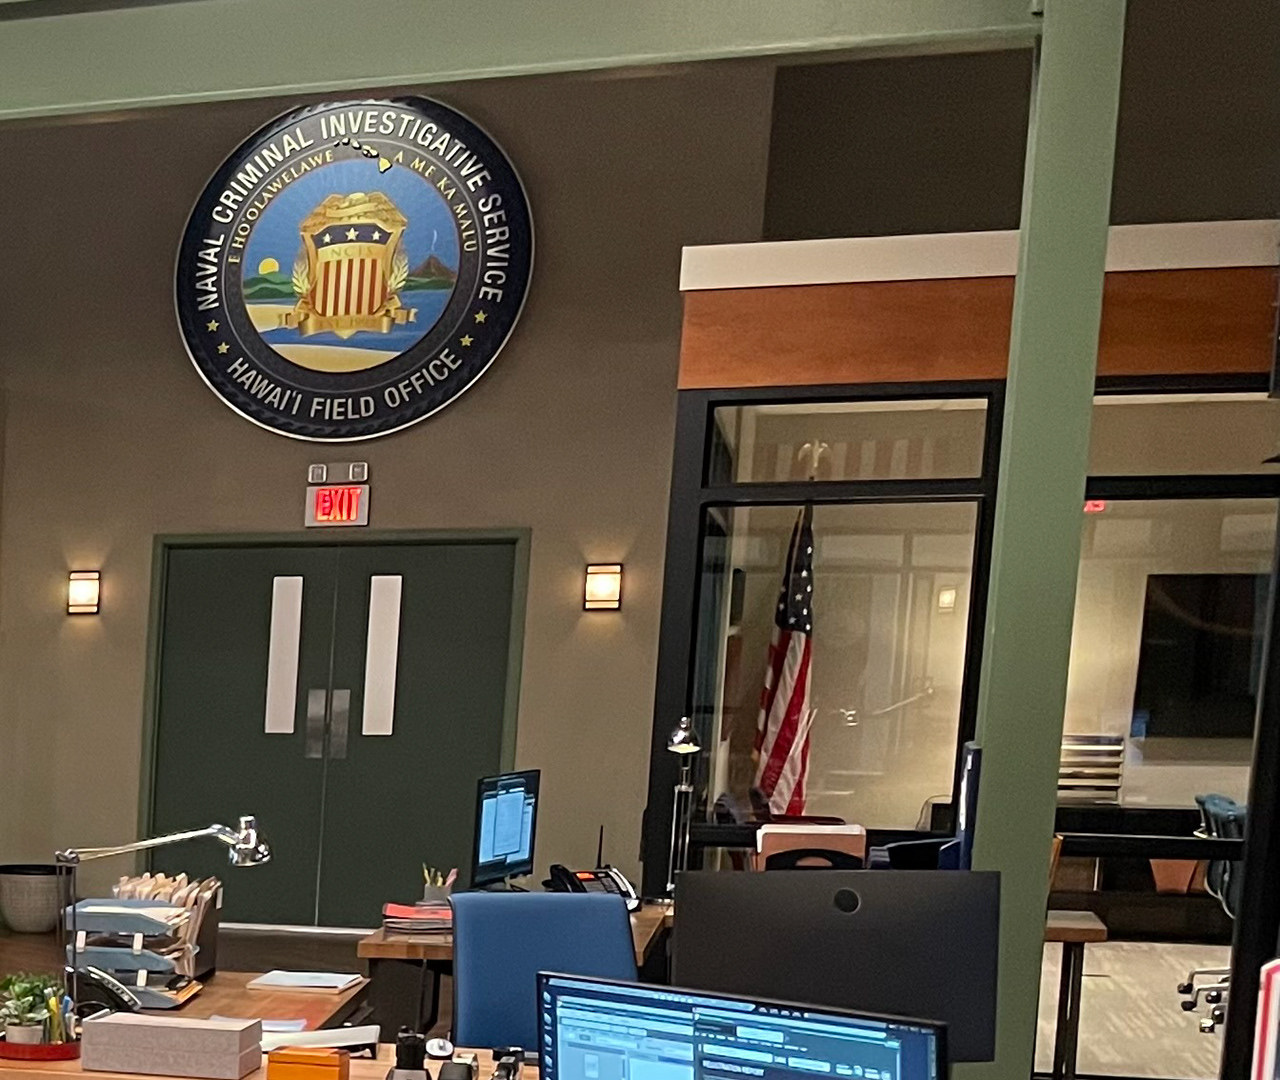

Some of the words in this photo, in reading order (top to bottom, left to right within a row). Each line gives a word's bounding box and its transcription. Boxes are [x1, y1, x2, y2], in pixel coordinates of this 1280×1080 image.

[196, 233, 224, 310] NAVAL
[212, 127, 314, 224] CRIMINAL
[321, 110, 491, 192] INVESTIGATIVE
[478, 193, 510, 302] SERVICE
[228, 255, 240, 264] E
[393, 150, 404, 163] A
[410, 156, 436, 177] ME
[437, 177, 456, 200] KA
[453, 203, 477, 253] MALU
[331, 246, 373, 257] NCIS
[310, 396, 375, 420] FIELD
[384, 348, 463, 408] OFFICE
[317, 488, 361, 521] EXIT
